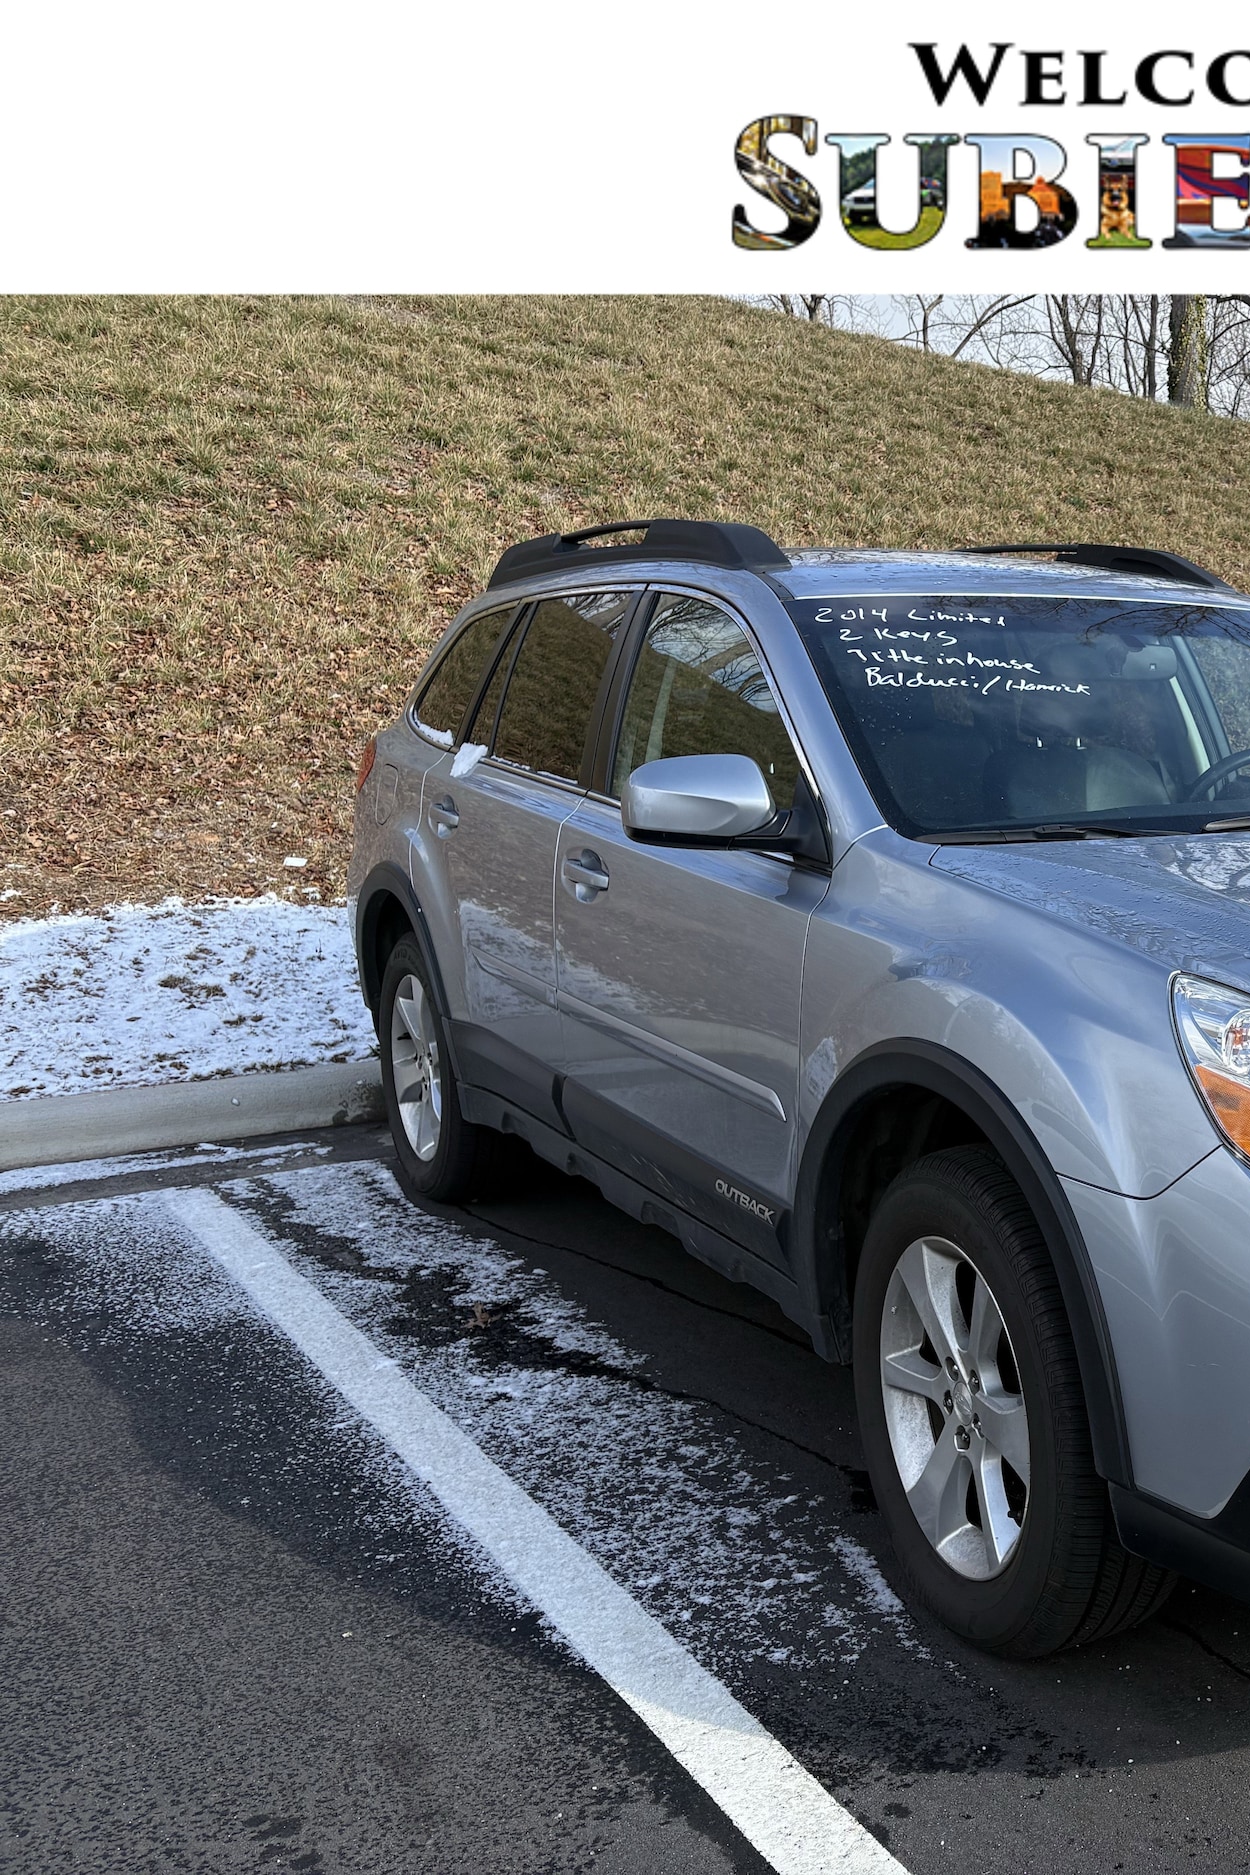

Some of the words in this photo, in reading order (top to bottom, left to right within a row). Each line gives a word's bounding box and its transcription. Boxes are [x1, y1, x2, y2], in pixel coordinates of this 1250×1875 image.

[814, 607, 888, 623] 2014
[839, 628, 863, 641] 2
[715, 1179, 775, 1225] OUTBACK
